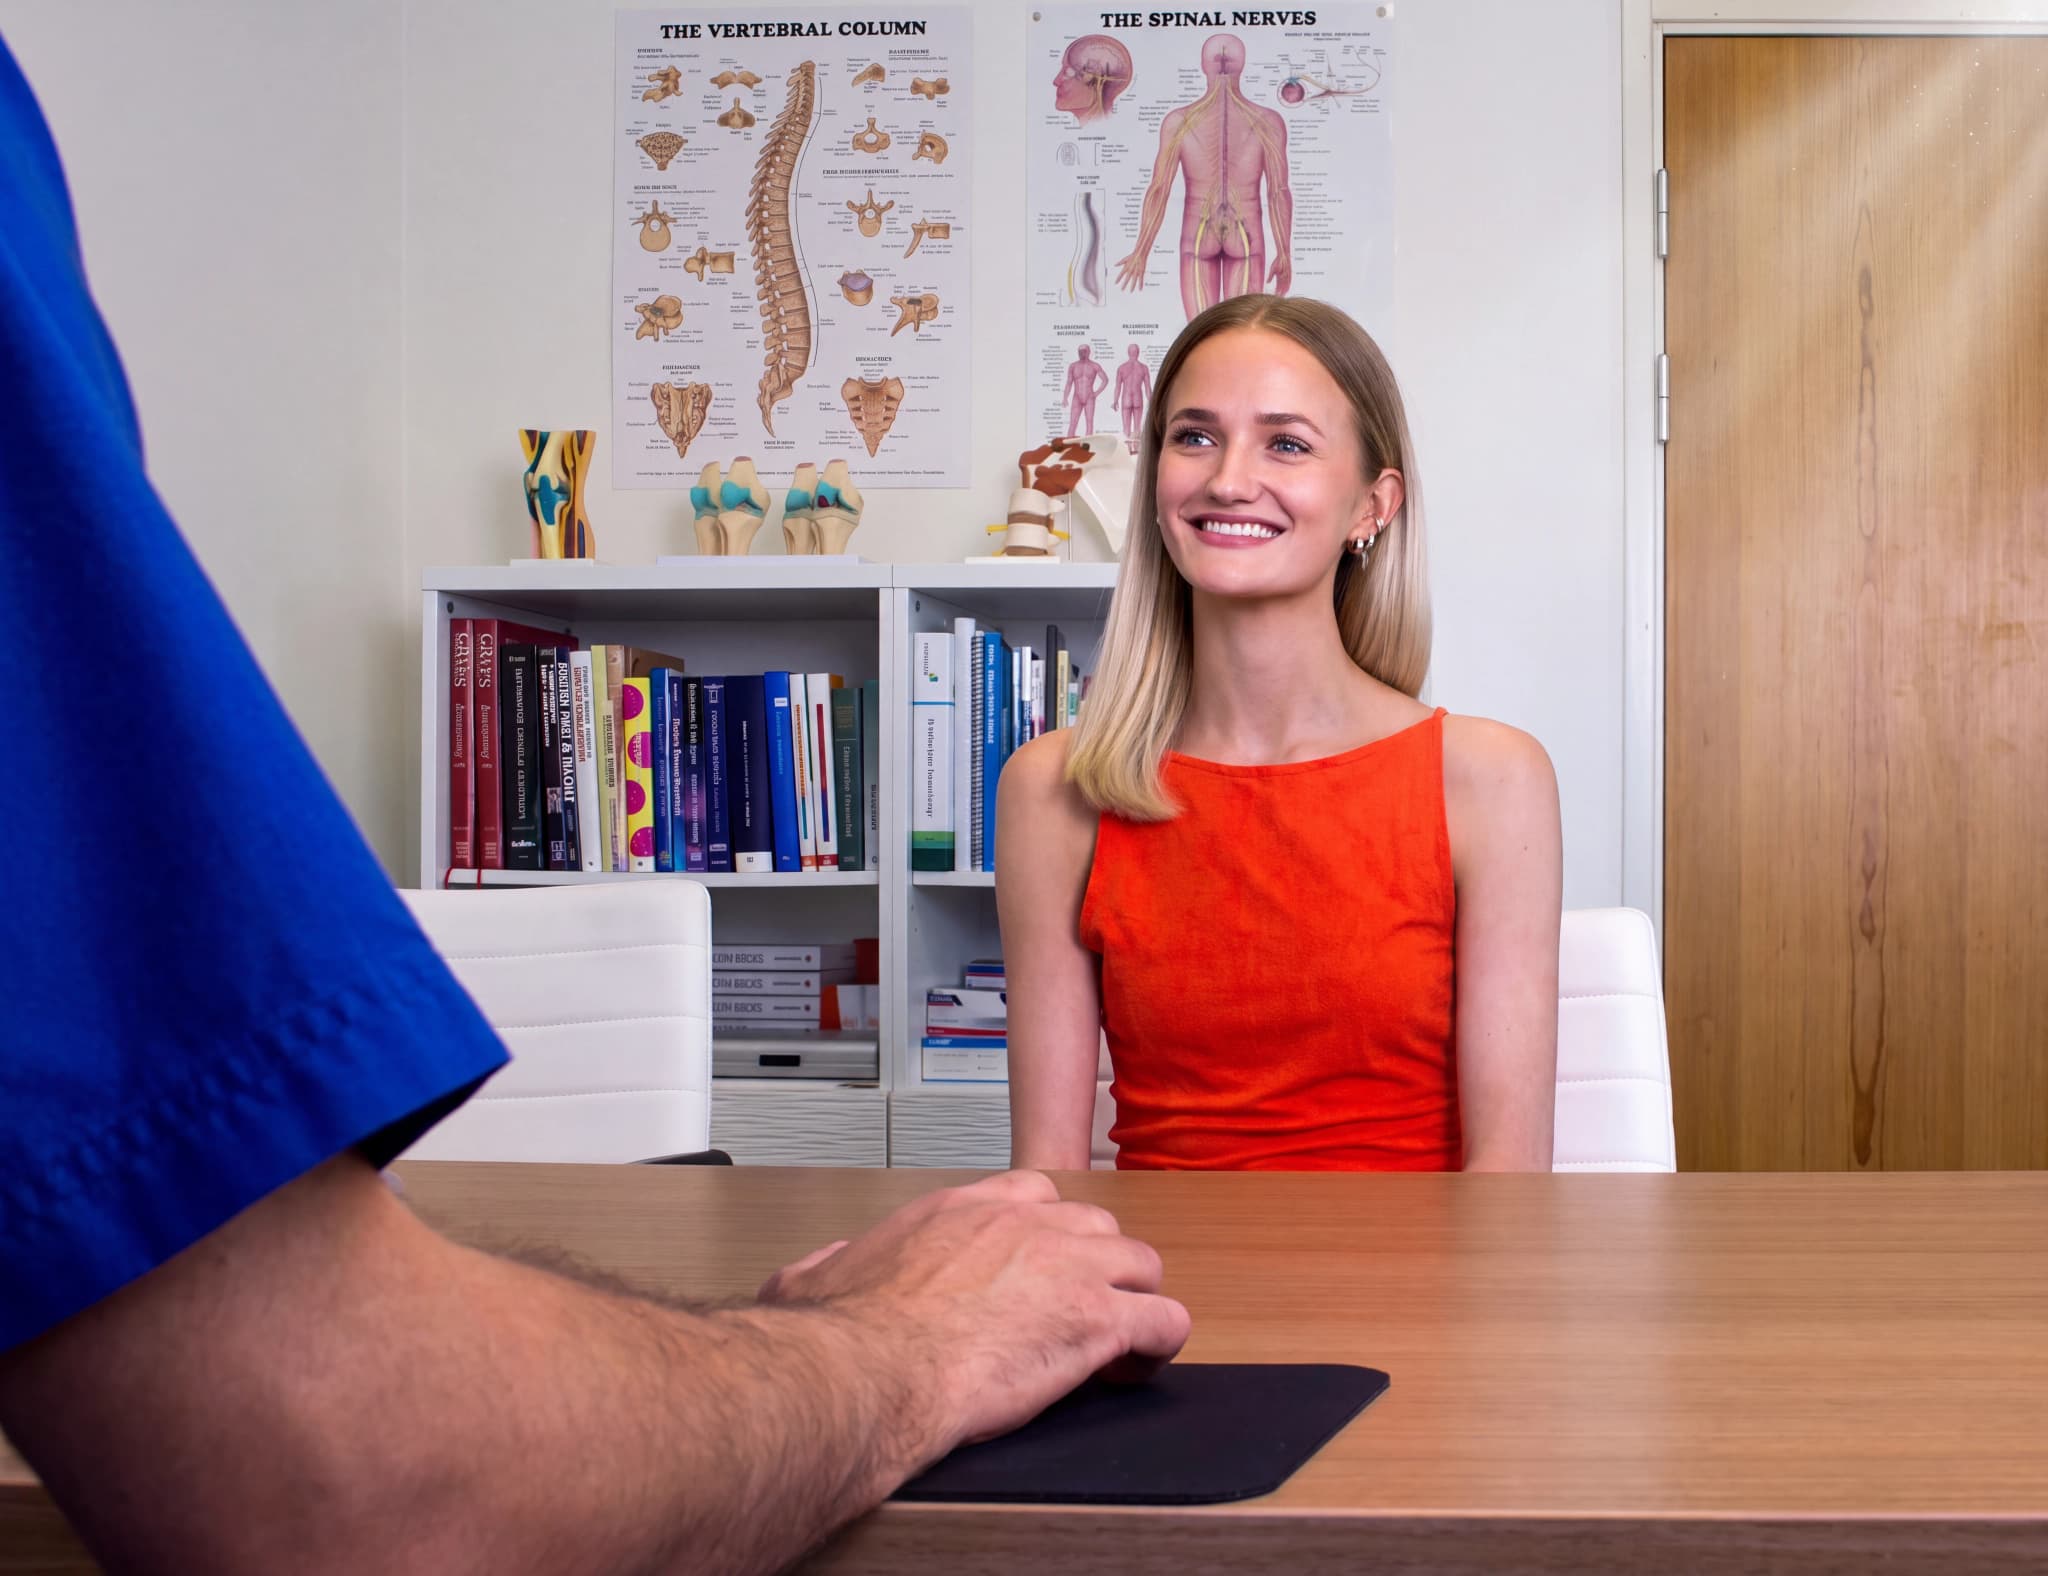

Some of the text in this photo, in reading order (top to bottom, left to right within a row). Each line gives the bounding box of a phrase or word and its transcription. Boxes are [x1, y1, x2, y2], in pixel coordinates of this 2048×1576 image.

[1100, 10, 1317, 28] THE SPINAL NERVES
[660, 20, 927, 39] THE VERTEBRAL COLUMN
